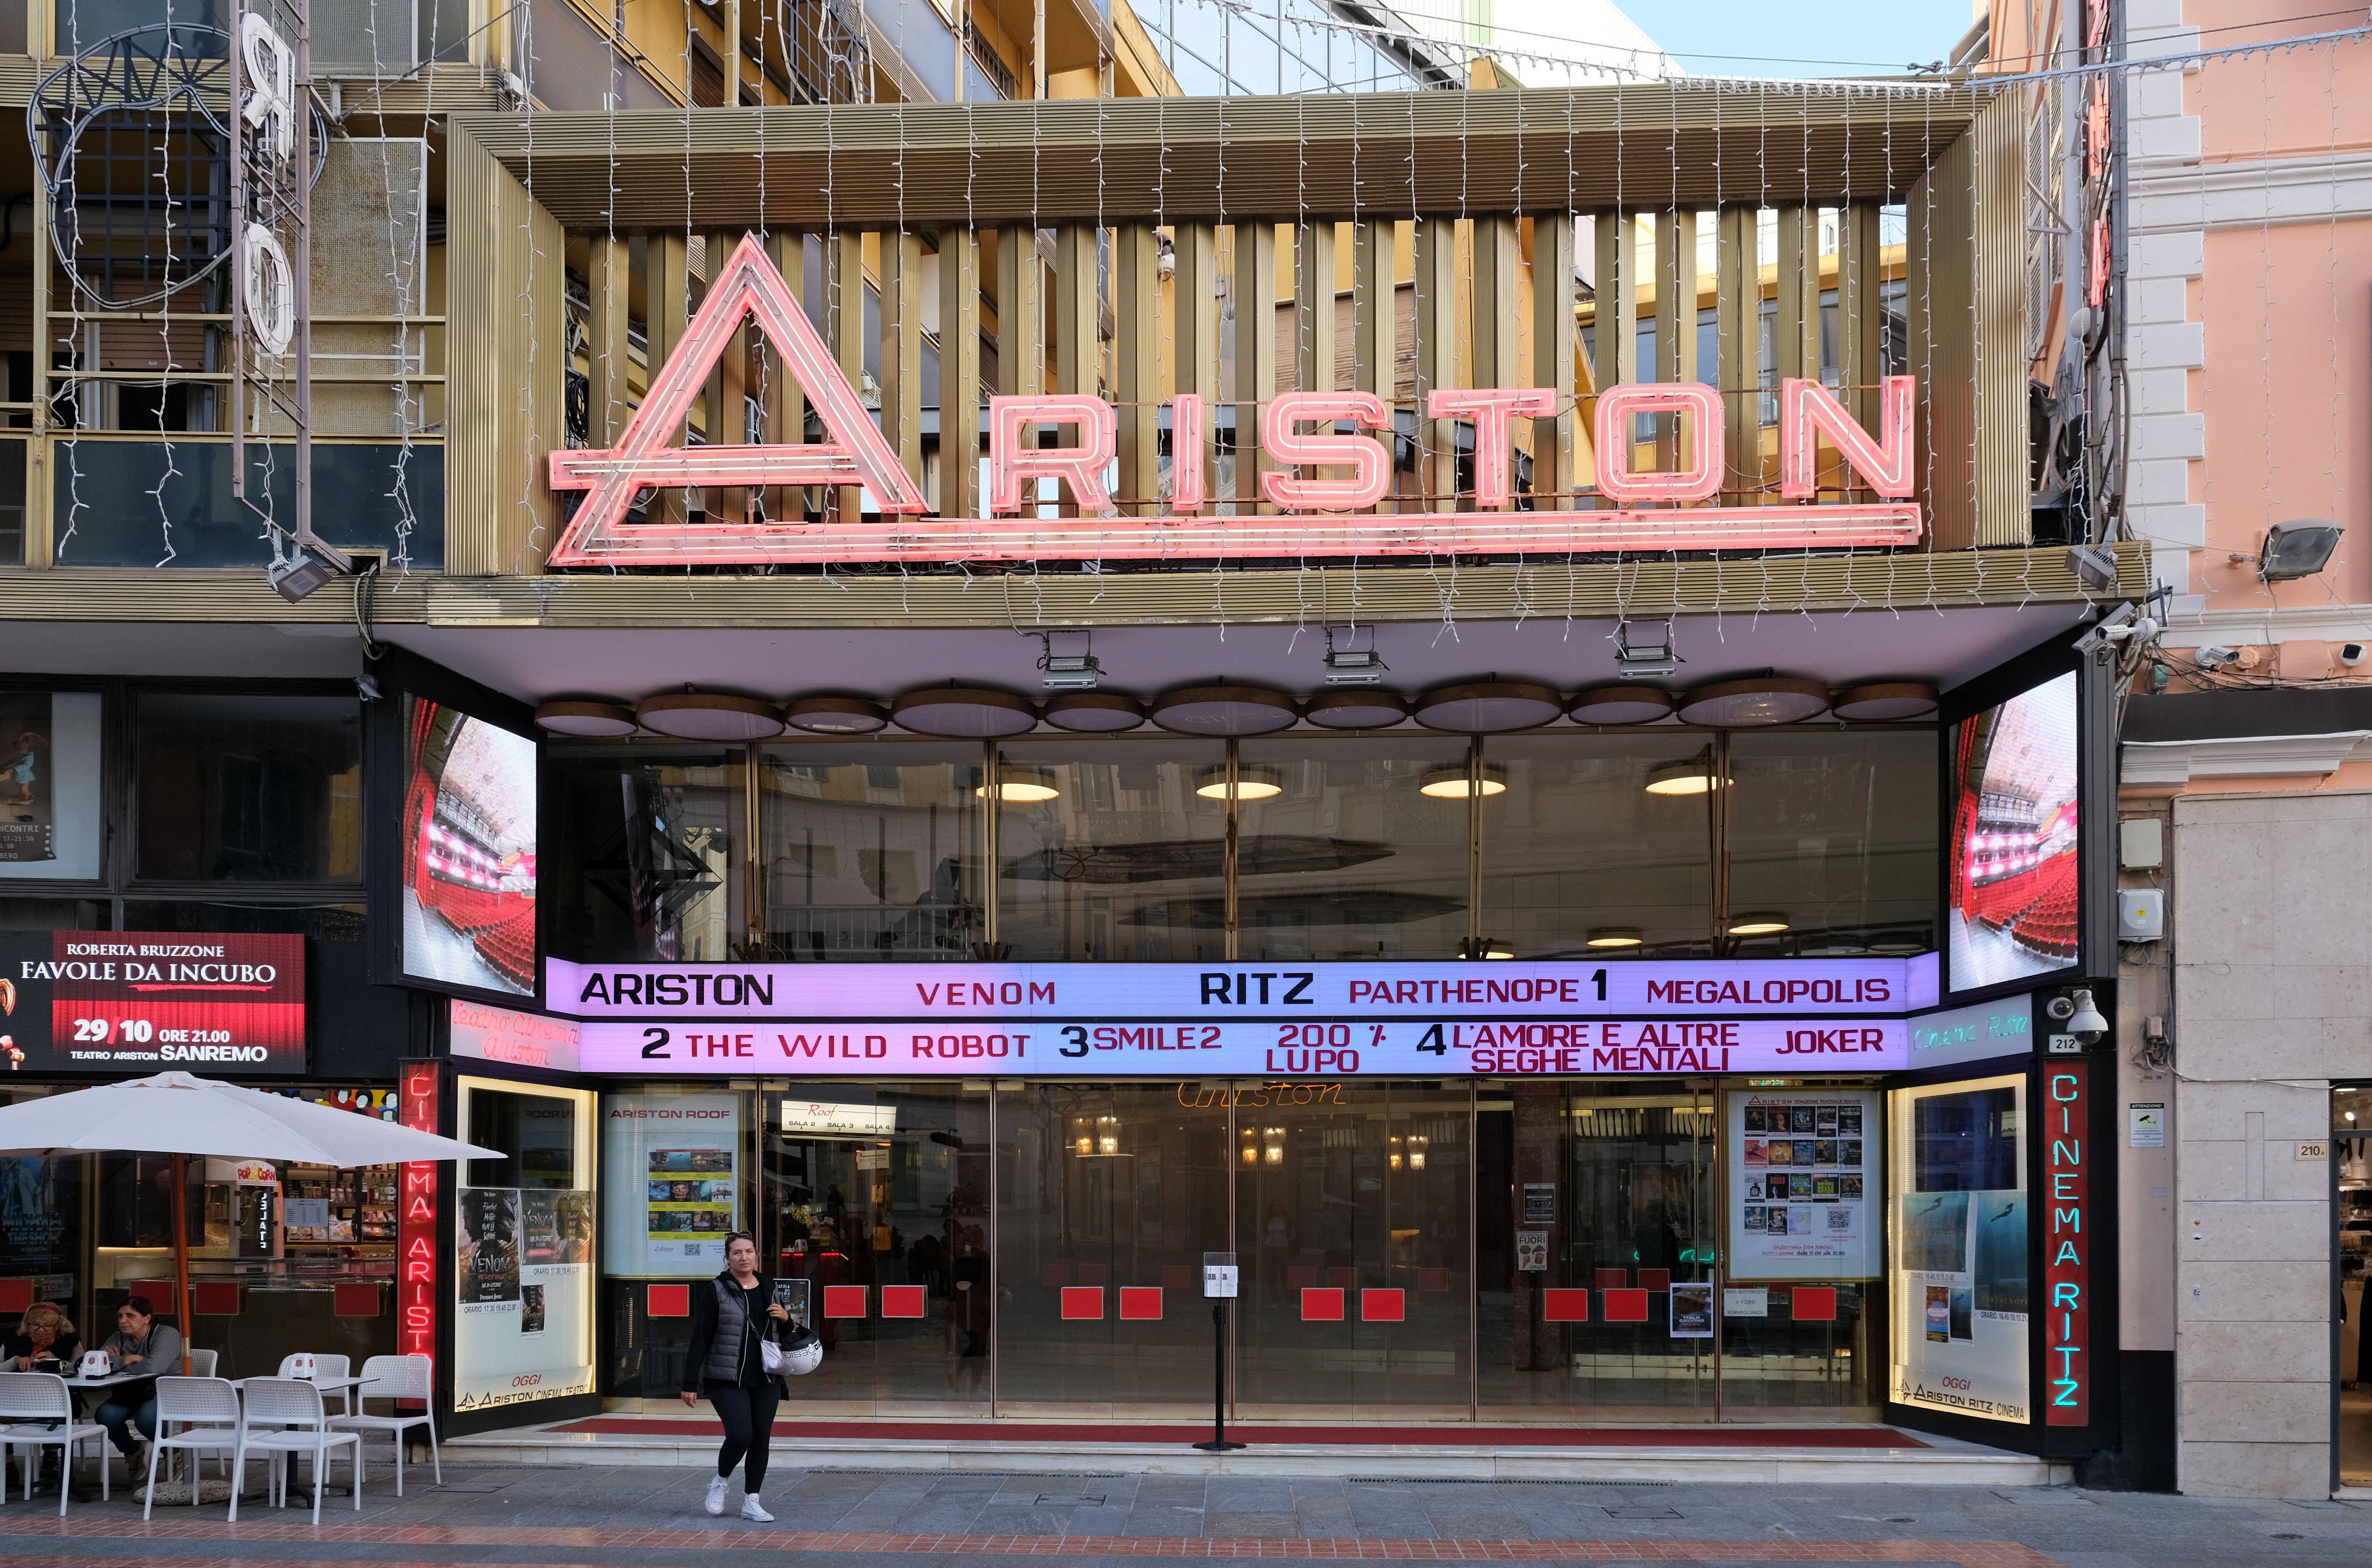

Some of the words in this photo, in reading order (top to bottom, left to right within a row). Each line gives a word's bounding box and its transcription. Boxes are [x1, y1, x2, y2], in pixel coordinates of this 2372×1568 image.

[549, 233, 1923, 567] ARISTON
[67, 944, 133, 956] ROBERTA
[140, 945, 224, 957] BRUZZONE
[21, 961, 116, 980] FAVOLE
[124, 963, 161, 981] DA
[169, 964, 276, 983] INCUBO
[581, 973, 773, 1005] ARISTON
[916, 982, 1055, 1005] VENOM
[1200, 972, 1314, 1004] RITZ
[1350, 979, 1579, 1004] PARTHENOPE
[1591, 969, 1606, 1001] 1
[1648, 979, 1890, 1004] MEGALOPOLIS
[159, 1030, 189, 1042] ORE
[192, 1030, 230, 1042] 21.00
[513, 1014, 579, 1045] Cinema
[1059, 1026, 1088, 1057] 3
[1278, 1024, 1350, 1048] 200
[1417, 1024, 1447, 1056] 4
[1453, 1024, 1589, 1048] L'AMORE
[1602, 1024, 1621, 1047] E
[1636, 1023, 1739, 1048] ALTRE
[70, 1051, 110, 1060] TEATRO
[113, 1052, 158, 1060] ARISTON
[160, 1046, 268, 1062] SANREMO
[642, 1028, 671, 1059] 2
[686, 1034, 754, 1057] THE
[777, 1035, 886, 1058] WILD
[912, 1034, 1031, 1058] ROBOT
[1775, 1029, 1884, 1055] JOKER
[2056, 1039, 2076, 1049] 212
[1266, 1049, 1359, 1073] LUPO
[1471, 1048, 1580, 1073] SEGHE
[1593, 1048, 1728, 1072] MENTALI
[808, 1104, 839, 1120] Roof
[1748, 1095, 1792, 1105] ARISTON
[610, 1109, 682, 1119] ARISTON
[686, 1110, 730, 1119] ROOF
[238, 1167, 251, 1180] POP
[258, 1167, 275, 1181] CORN
[2053, 1074, 2081, 1267] CINEMA
[469, 1249, 510, 1273] VENOM
[2054, 1283, 2081, 1406] RITZ
[512, 1374, 542, 1387] OGGI
[1942, 1377, 1971, 1391] OGGI
[478, 1391, 533, 1409] ARISTON
[535, 1388, 562, 1401] CINEMA
[1913, 1383, 1965, 1406] ARISTON
[1969, 1398, 1993, 1411] RITZ
[1996, 1402, 2025, 1420] CINEMA
